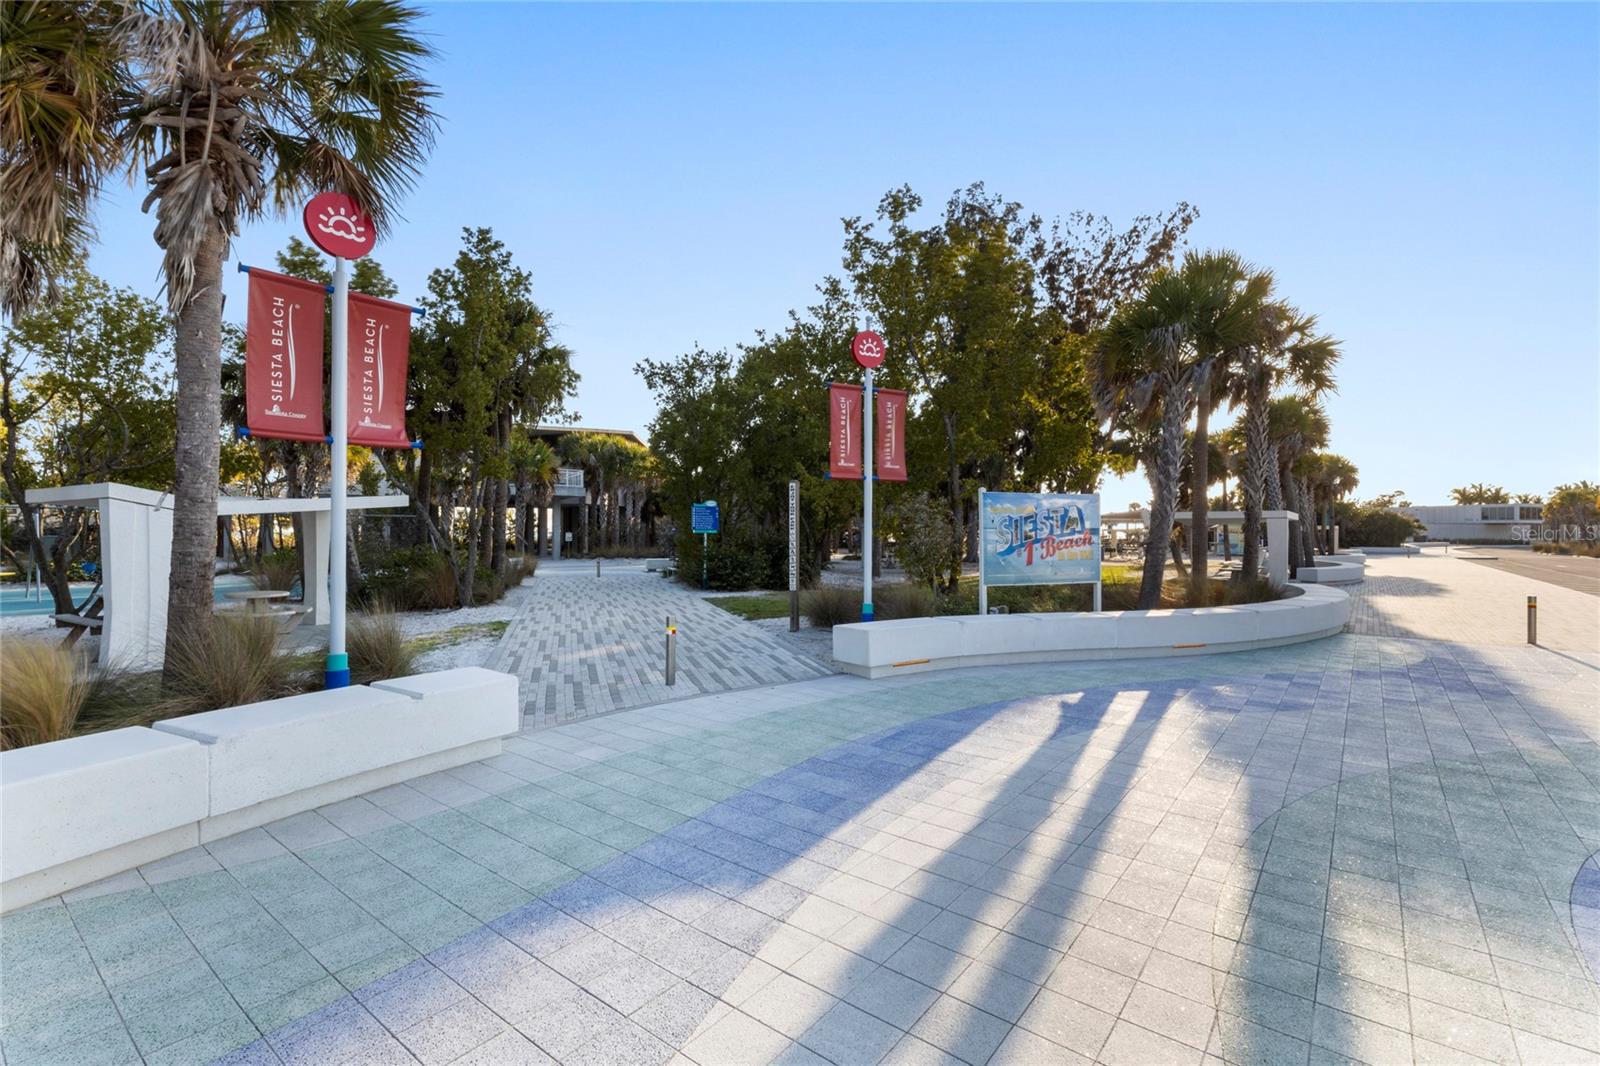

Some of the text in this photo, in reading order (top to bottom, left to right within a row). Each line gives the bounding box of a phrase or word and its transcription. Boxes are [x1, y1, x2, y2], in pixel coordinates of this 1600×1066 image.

[271, 297, 284, 346] BEACH
[271, 353, 283, 402] SIESTA
[363, 318, 376, 414] SIESTA BEACH
[995, 504, 1084, 553] SIESTA
[1040, 529, 1094, 560] Beach
